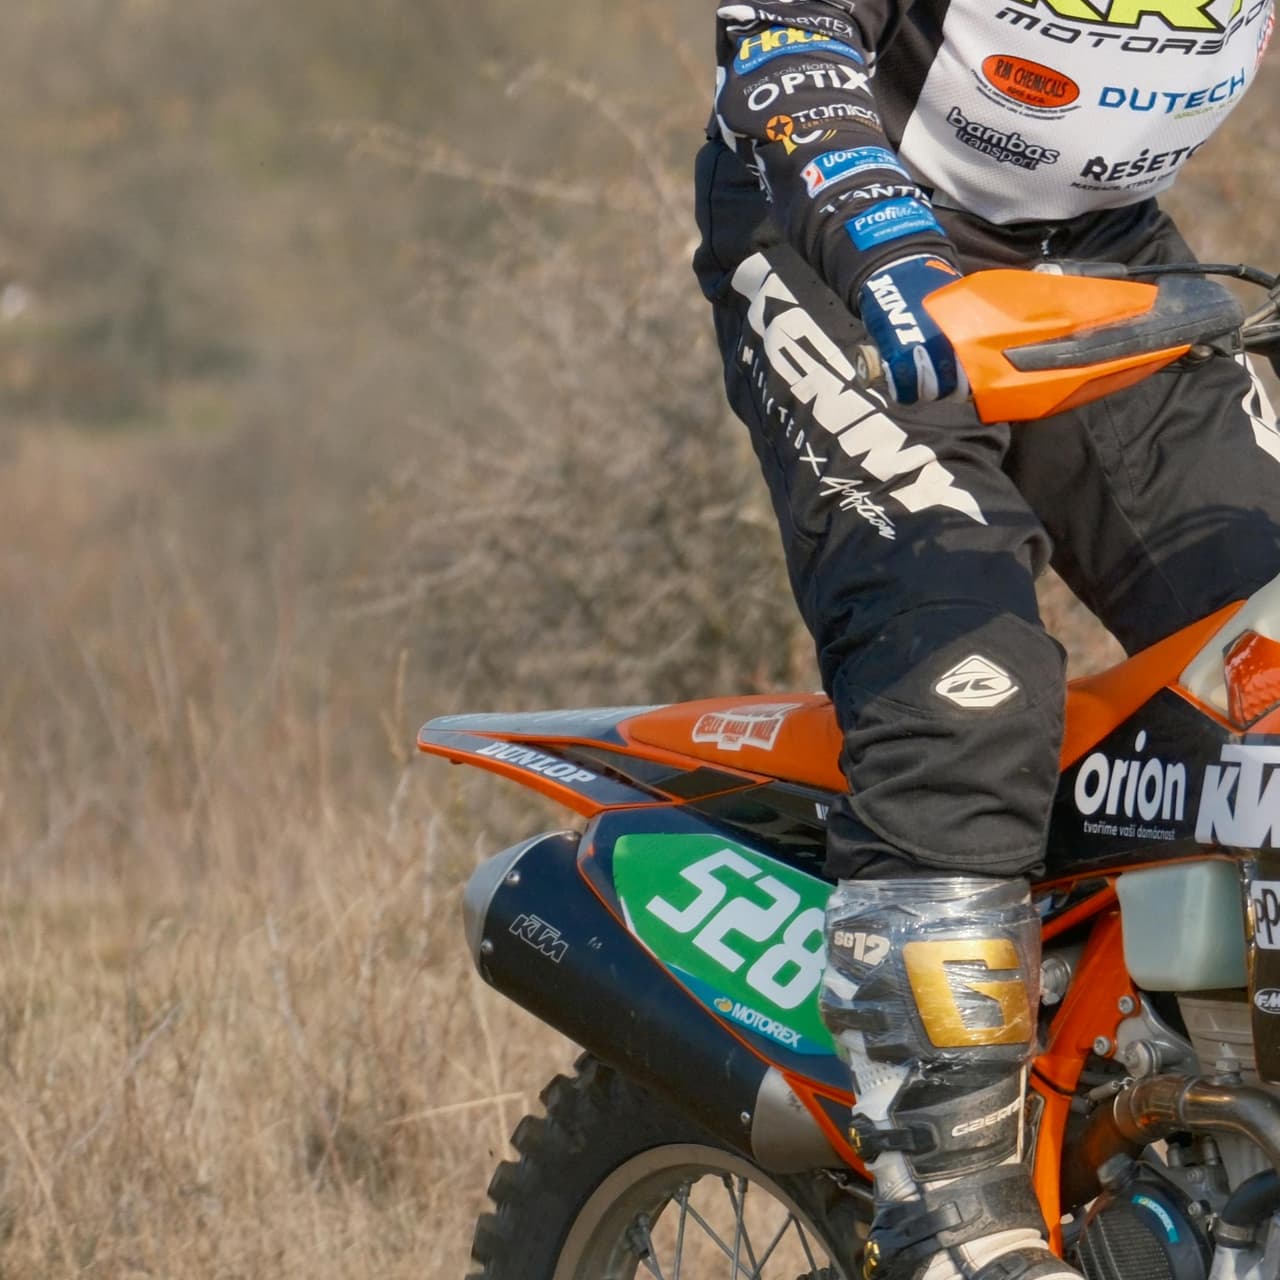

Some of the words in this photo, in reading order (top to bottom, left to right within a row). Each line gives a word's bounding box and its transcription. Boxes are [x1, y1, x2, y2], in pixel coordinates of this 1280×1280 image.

[747, 63, 874, 112] OPTIX
[1097, 66, 1246, 115] DUTECH
[946, 105, 1061, 165] bambas
[956, 128, 1040, 171] transport
[866, 274, 927, 346] KINI
[730, 251, 989, 526] KENNY
[475, 741, 599, 784] DUNLOP
[1073, 728, 1187, 821] orion
[508, 913, 570, 964] KTM
[645, 847, 827, 1011] 528
[729, 1001, 803, 1049] MOTOREX
